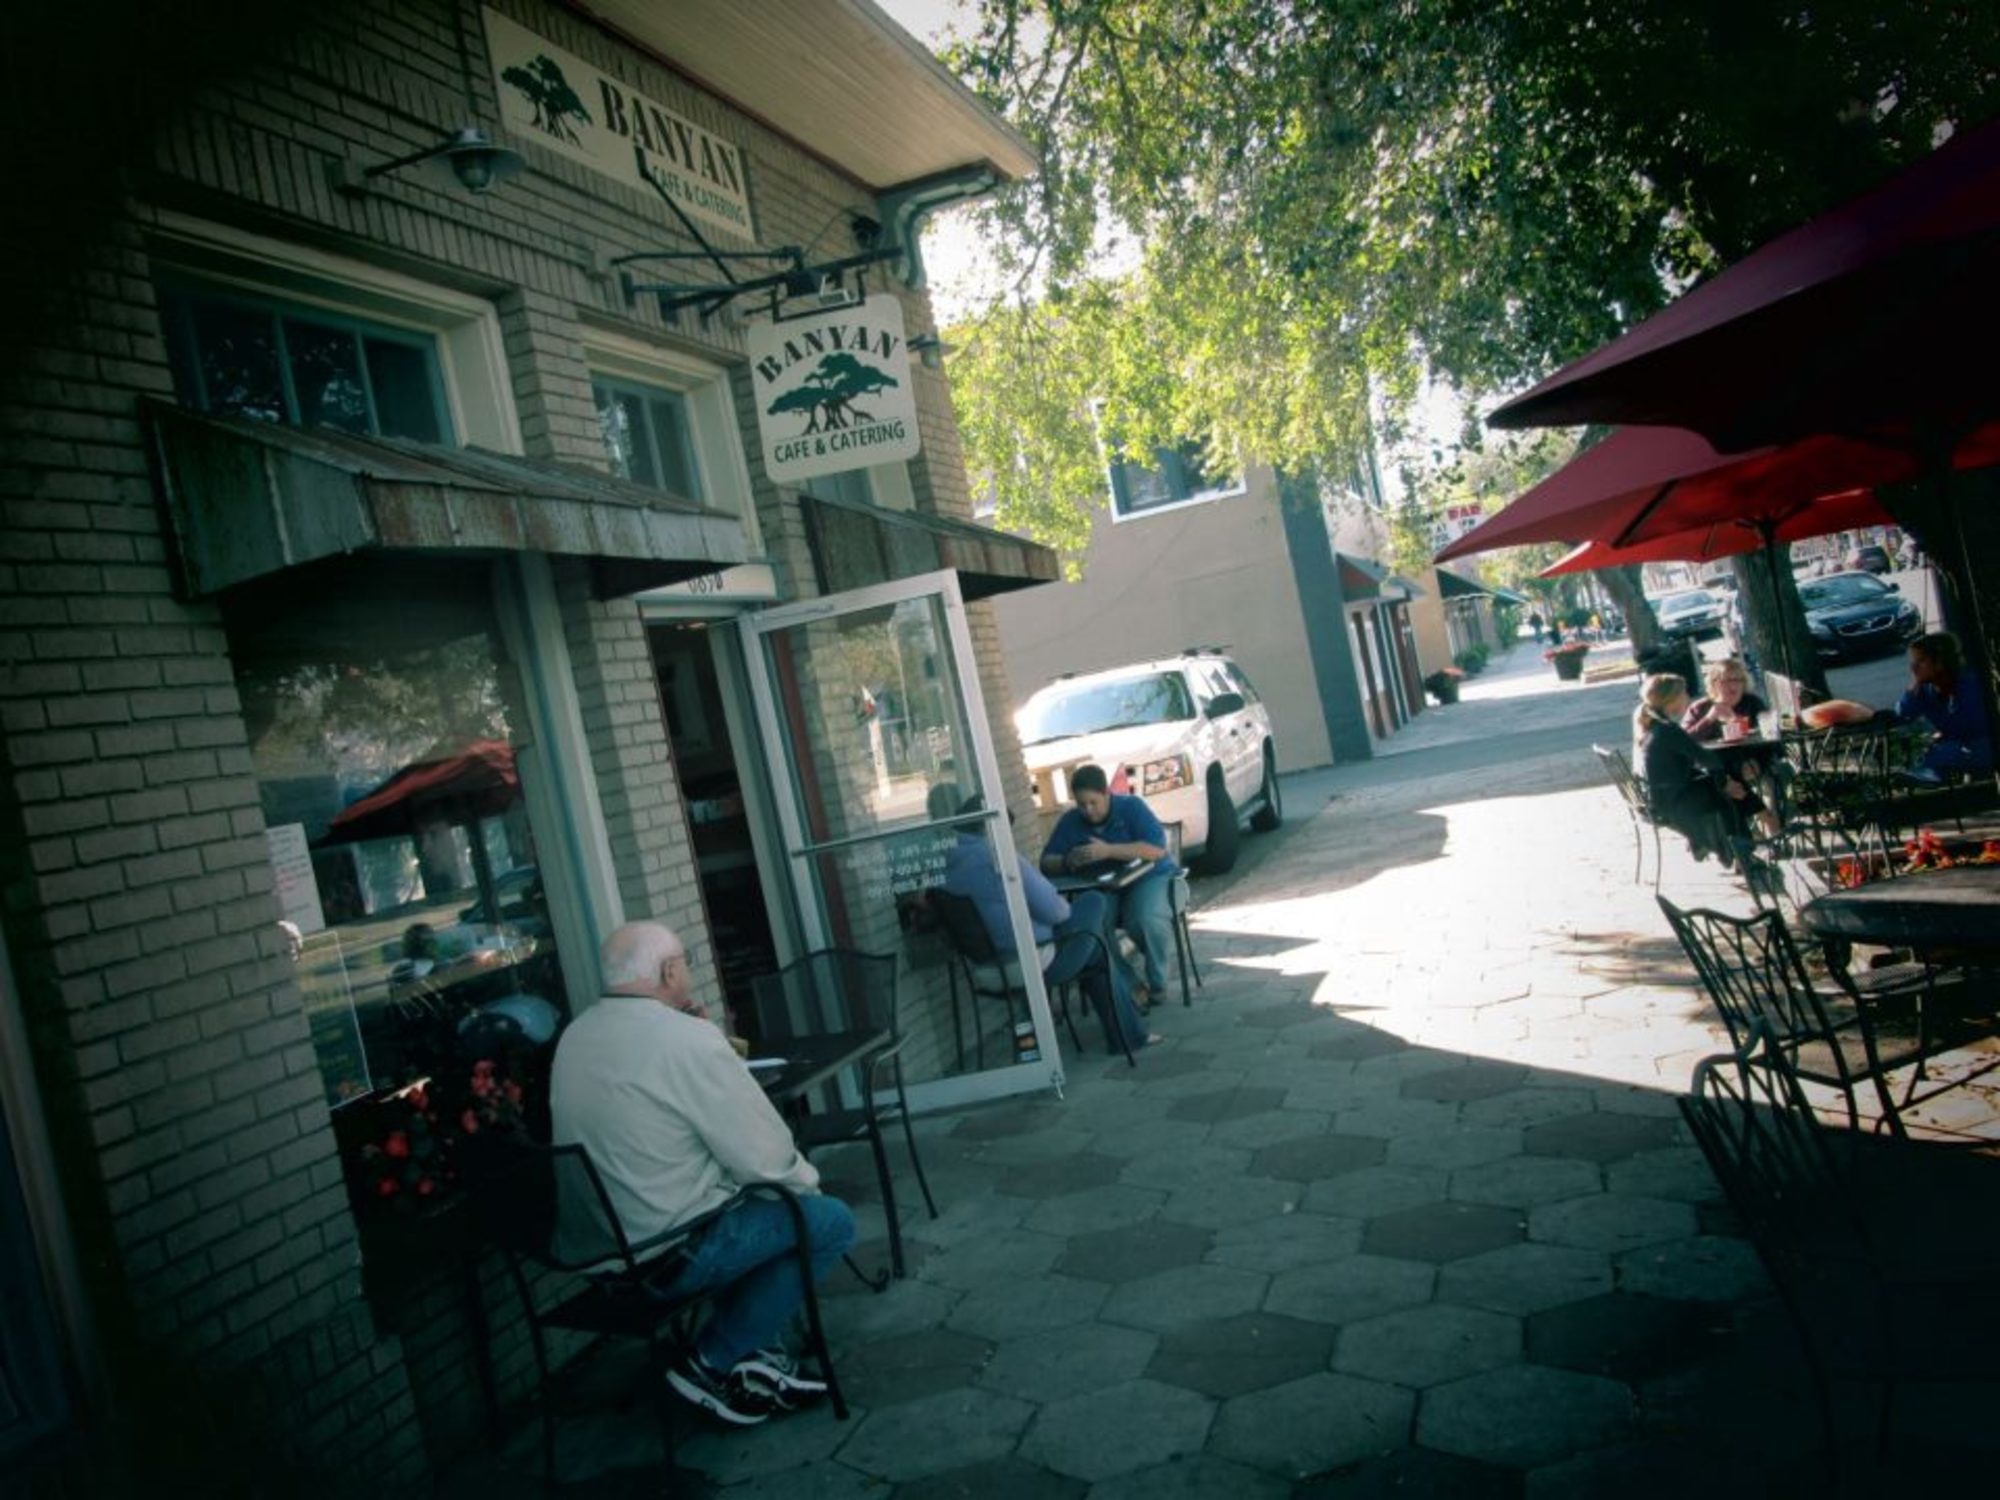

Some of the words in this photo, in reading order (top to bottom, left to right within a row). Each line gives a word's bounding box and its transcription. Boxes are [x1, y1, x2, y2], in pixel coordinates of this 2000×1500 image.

[598, 78, 740, 196] BANYAN
[756, 326, 900, 384] BANYAN
[774, 441, 810, 463] CAFE
[815, 438, 826, 455] &
[830, 420, 905, 451] CATERING
